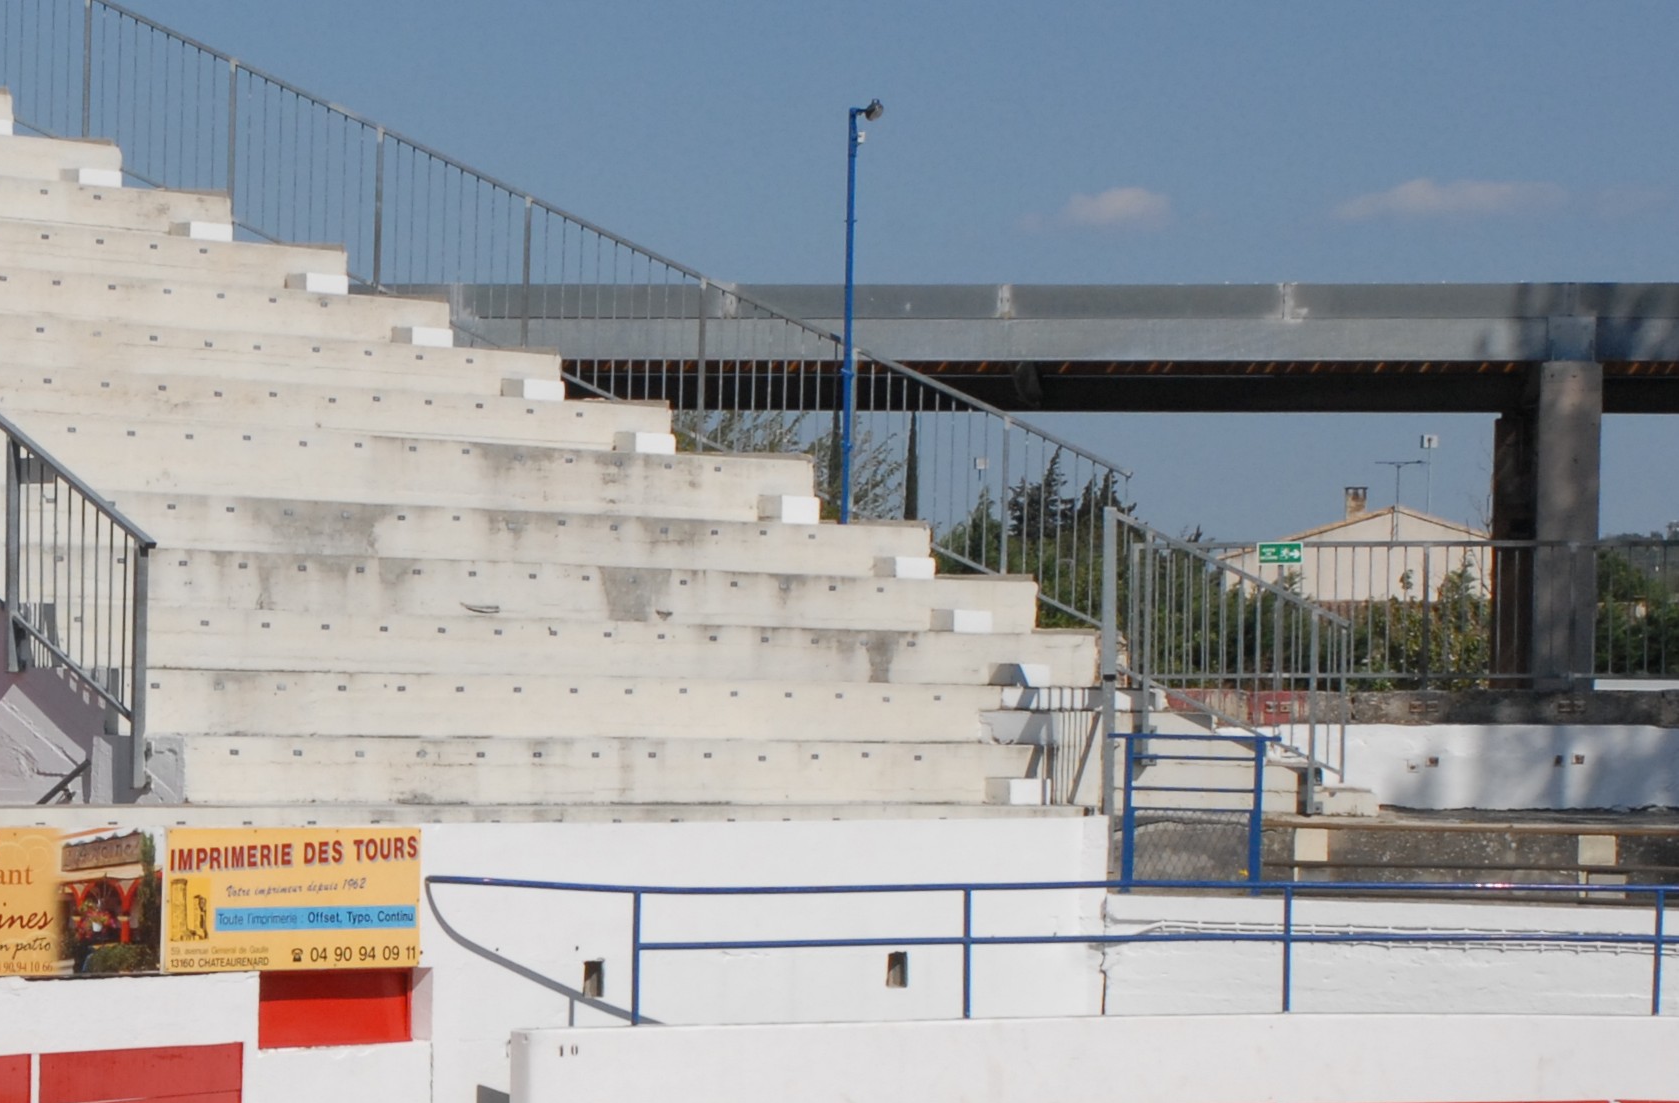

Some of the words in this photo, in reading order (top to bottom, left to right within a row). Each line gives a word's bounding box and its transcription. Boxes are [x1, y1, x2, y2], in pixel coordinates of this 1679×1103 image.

[170, 842, 292, 872] IMPRIMERIE
[303, 839, 343, 865] DES
[353, 836, 418, 862] TOURS
[225, 885, 250, 898] Votre
[342, 877, 367, 890] 1962
[219, 913, 244, 926] Toute
[247, 912, 298, 926] l'imprimerie
[377, 910, 414, 923] Continu
[12, 937, 51, 960] patio
[309, 947, 328, 962] 04
[334, 946, 353, 962] 90
[358, 946, 376, 961] 94
[382, 945, 400, 961] 09
[405, 945, 416, 960] 11
[30, 962, 39, 972] 10
[42, 962, 53, 972] 66
[170, 958, 195, 969] 13160
[197, 956, 270, 969] CHATEAURENARD
